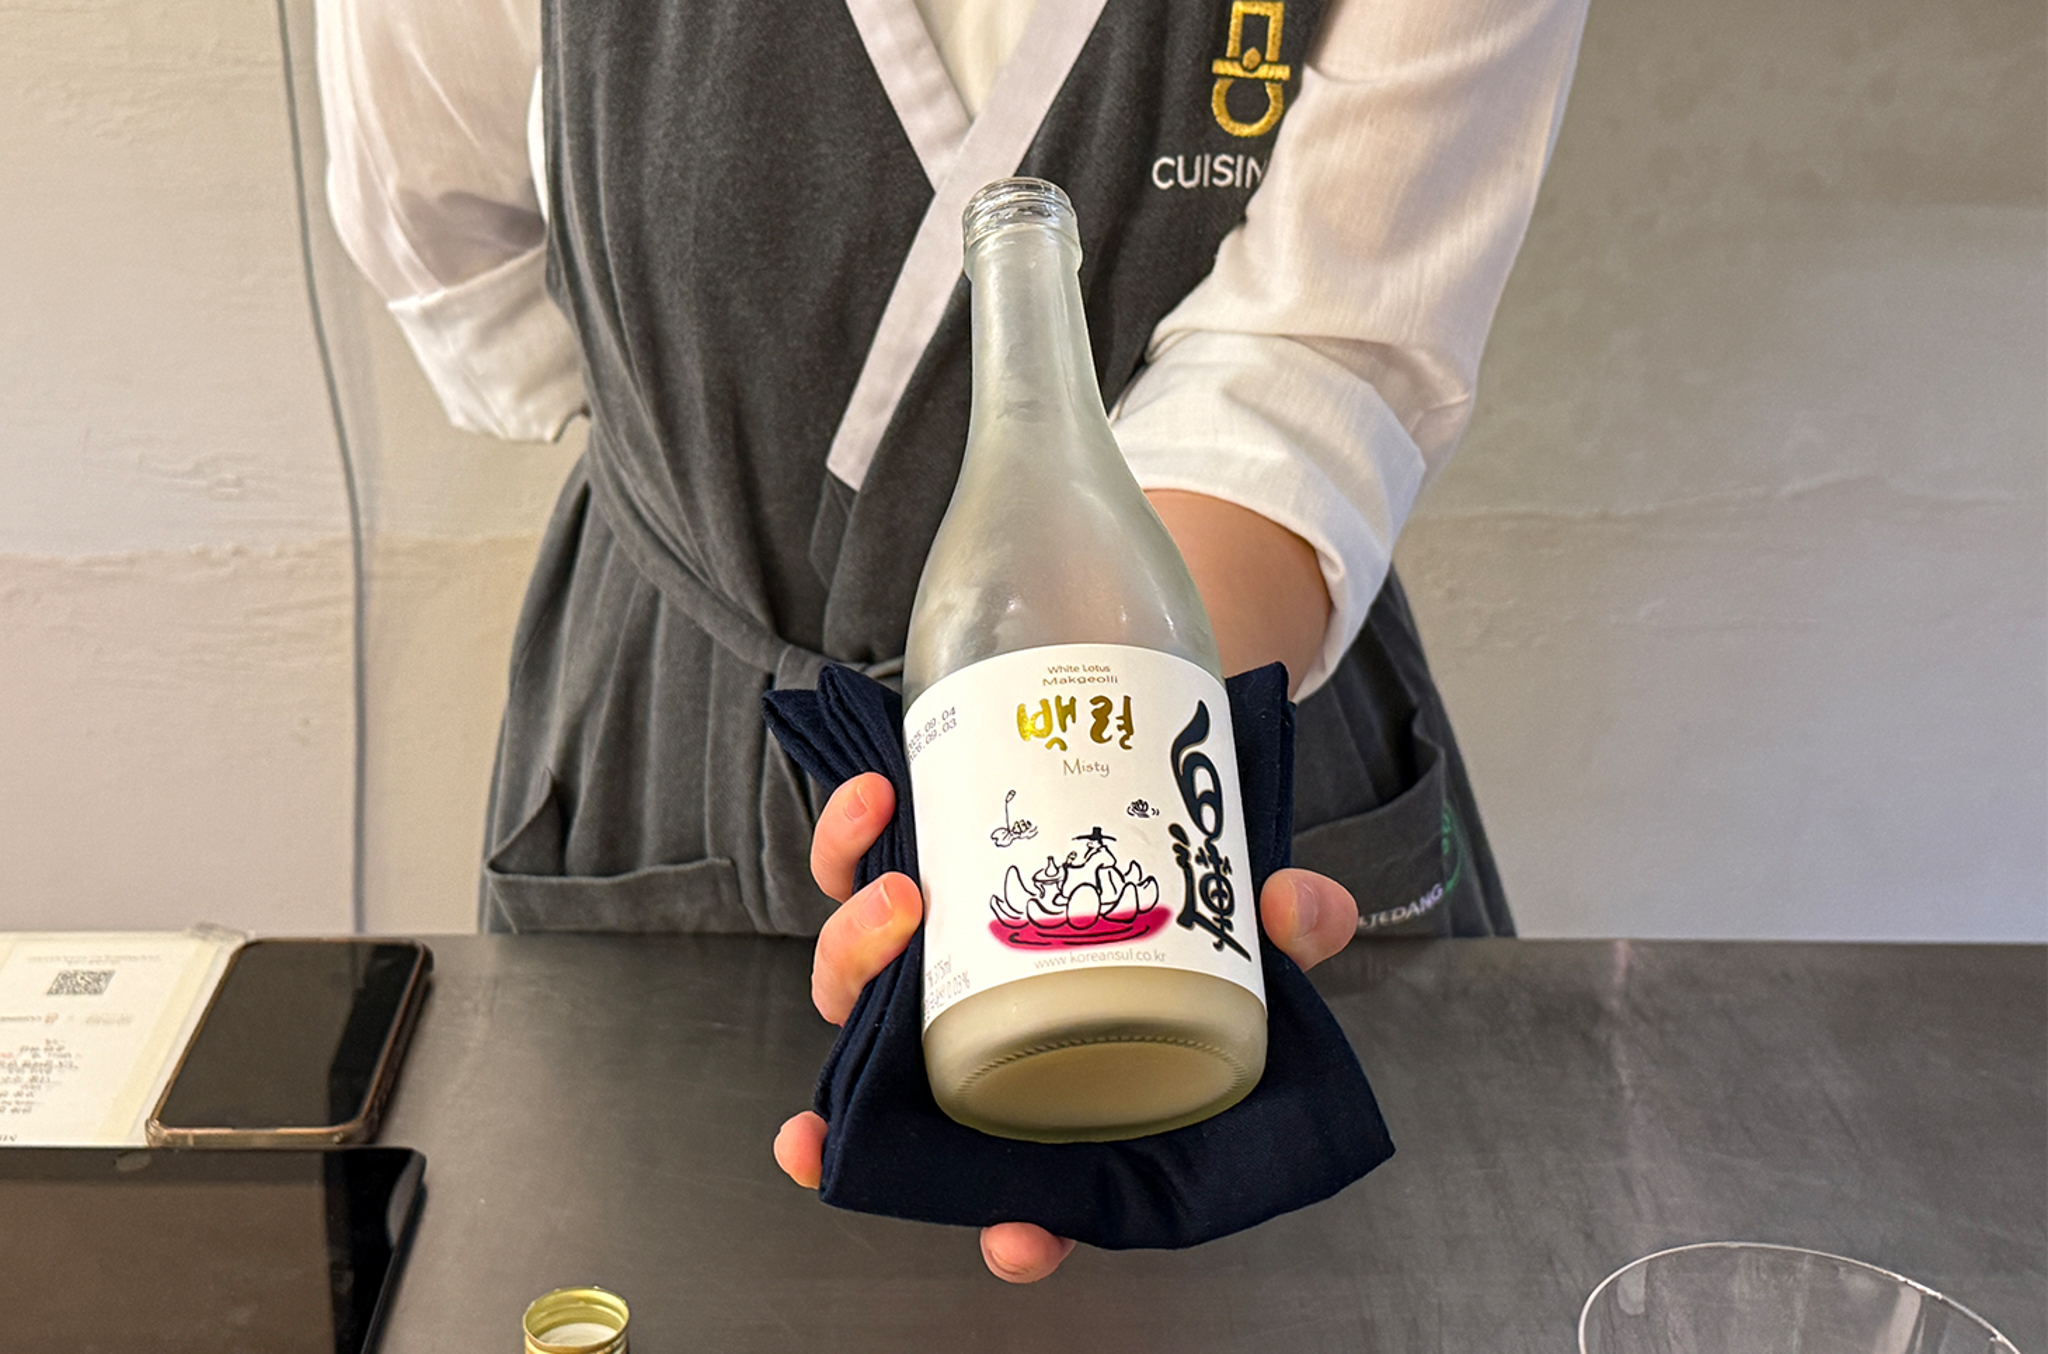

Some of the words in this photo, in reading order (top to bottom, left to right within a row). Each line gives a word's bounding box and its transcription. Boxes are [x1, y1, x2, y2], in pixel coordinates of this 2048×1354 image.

[1047, 664, 1080, 674] White
[1082, 664, 1111, 673] Lotus
[1063, 758, 1110, 778] Misty
